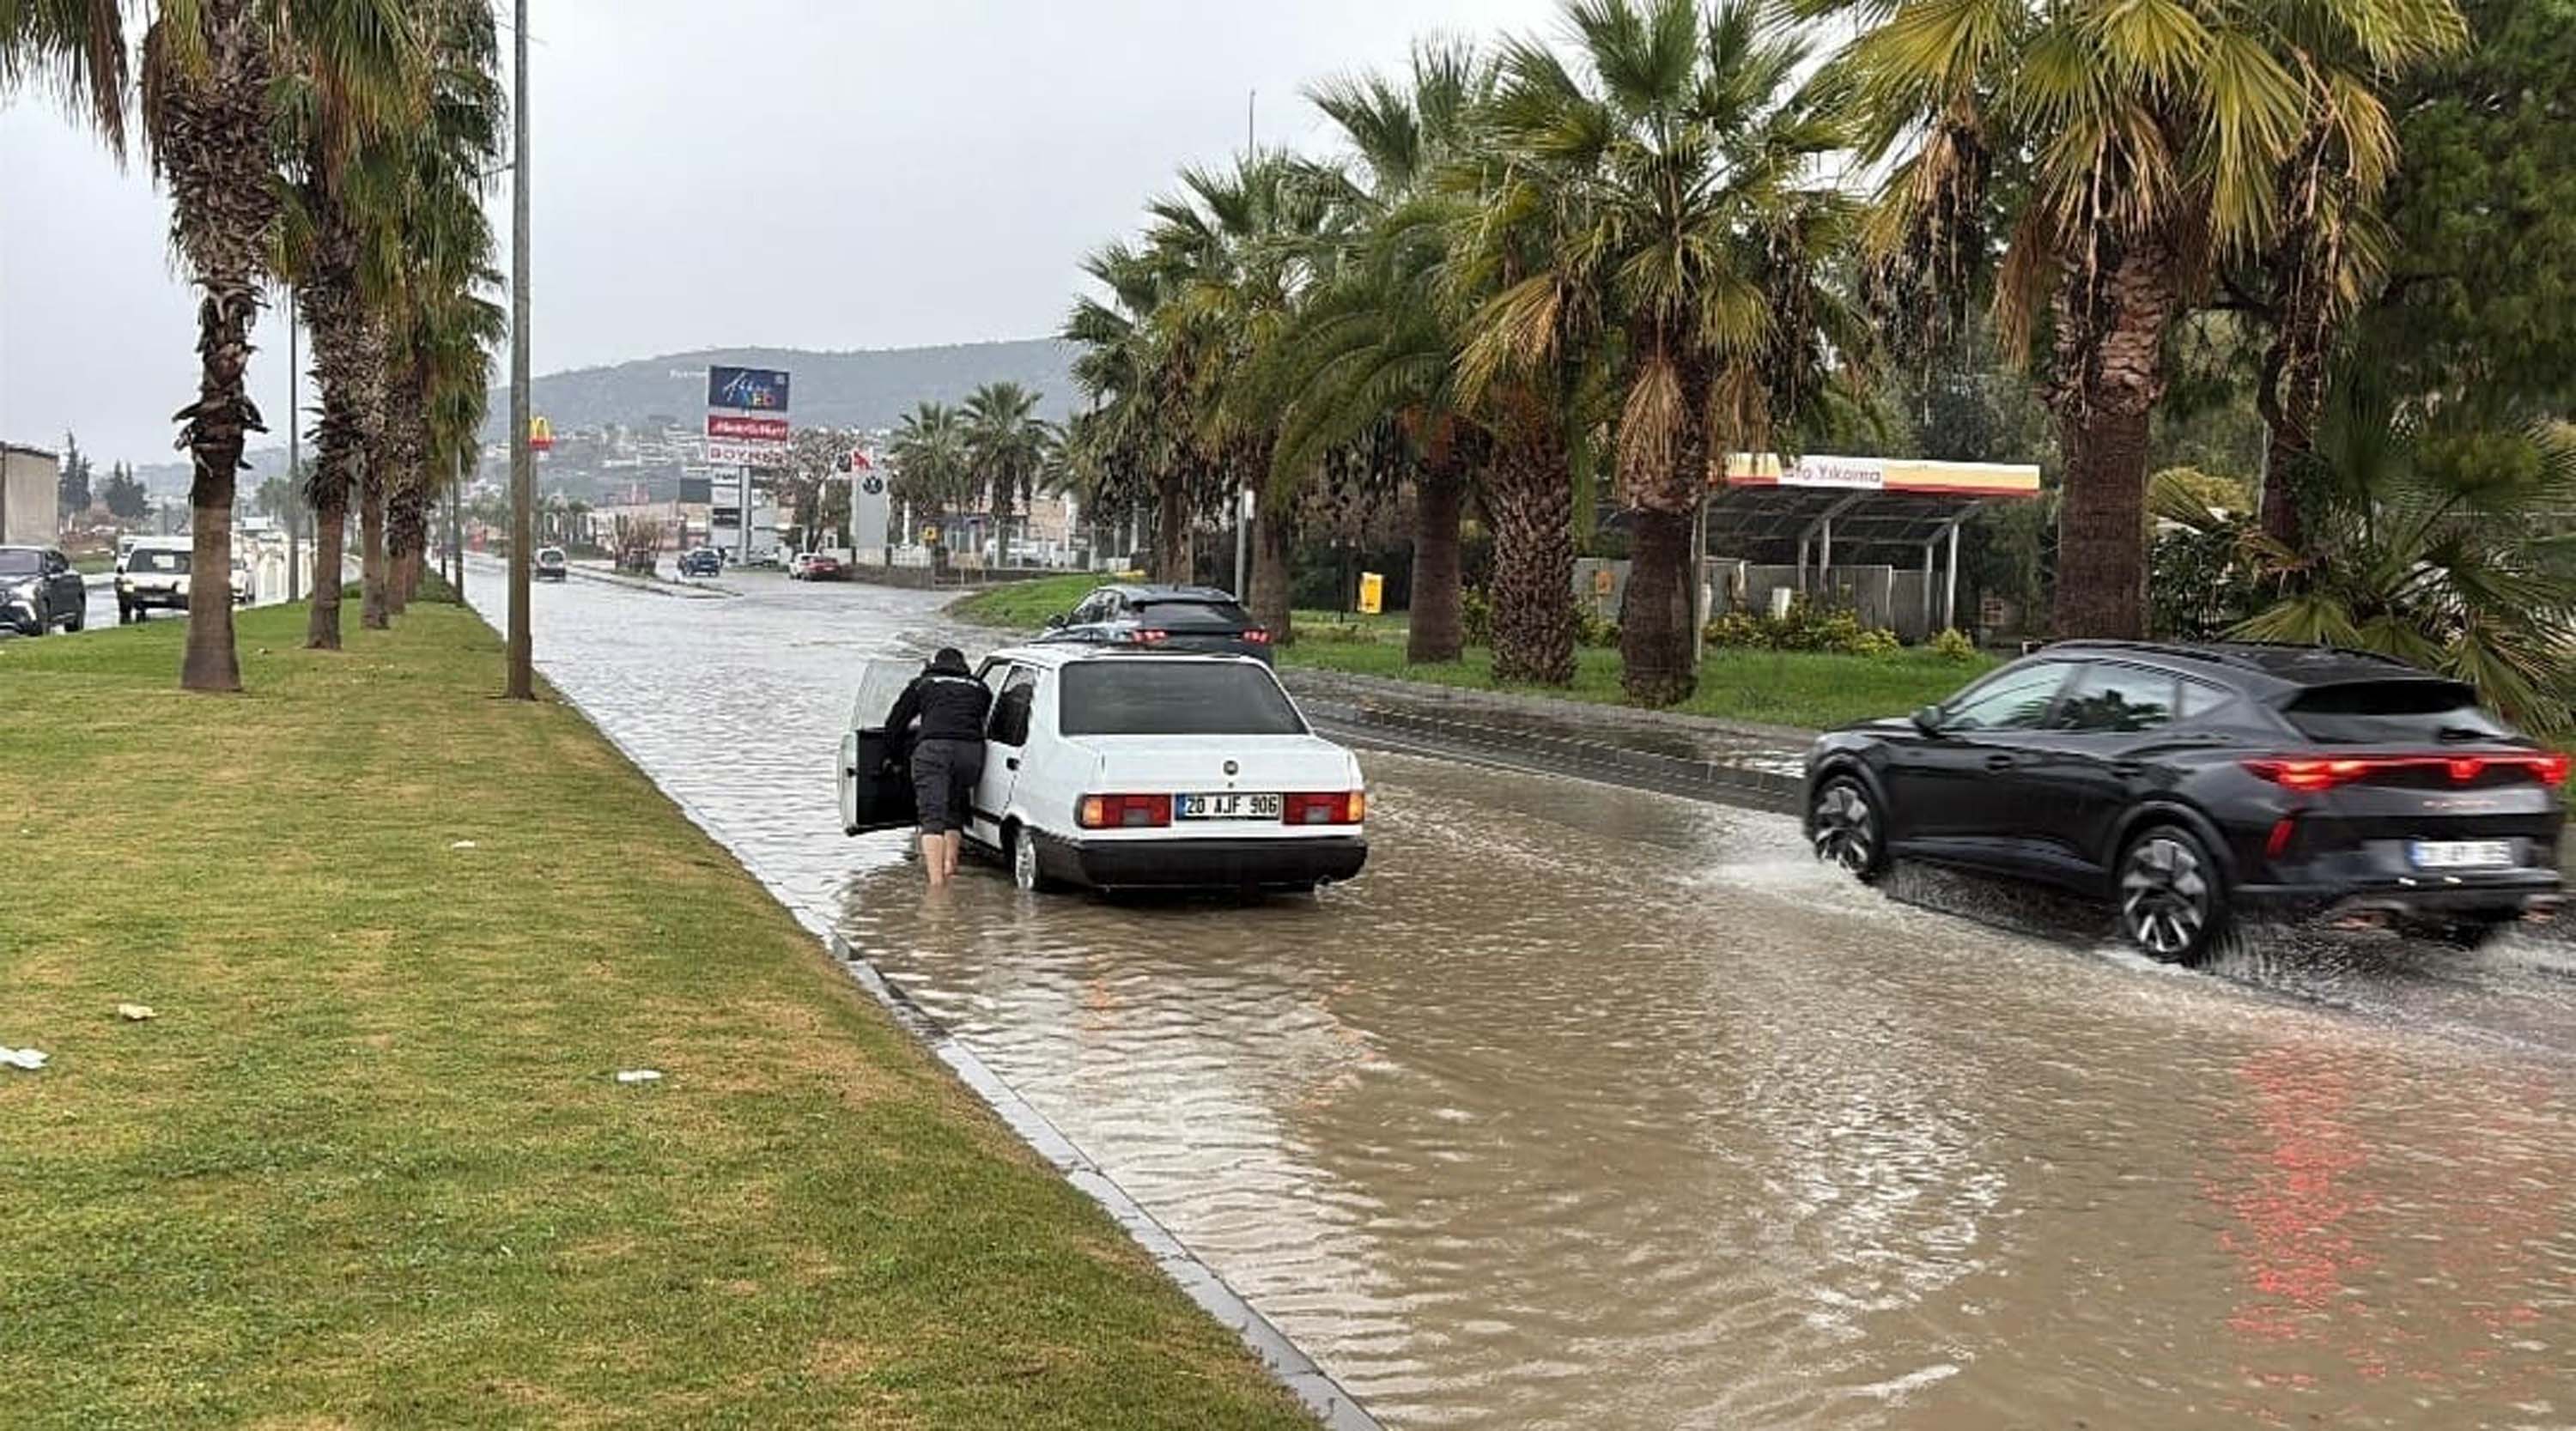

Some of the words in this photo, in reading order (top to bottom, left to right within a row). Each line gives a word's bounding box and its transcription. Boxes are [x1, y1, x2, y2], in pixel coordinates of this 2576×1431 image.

[1187, 797, 1206, 814] 20
[1213, 795, 1242, 814] AJF
[1249, 795, 1278, 814] 906
